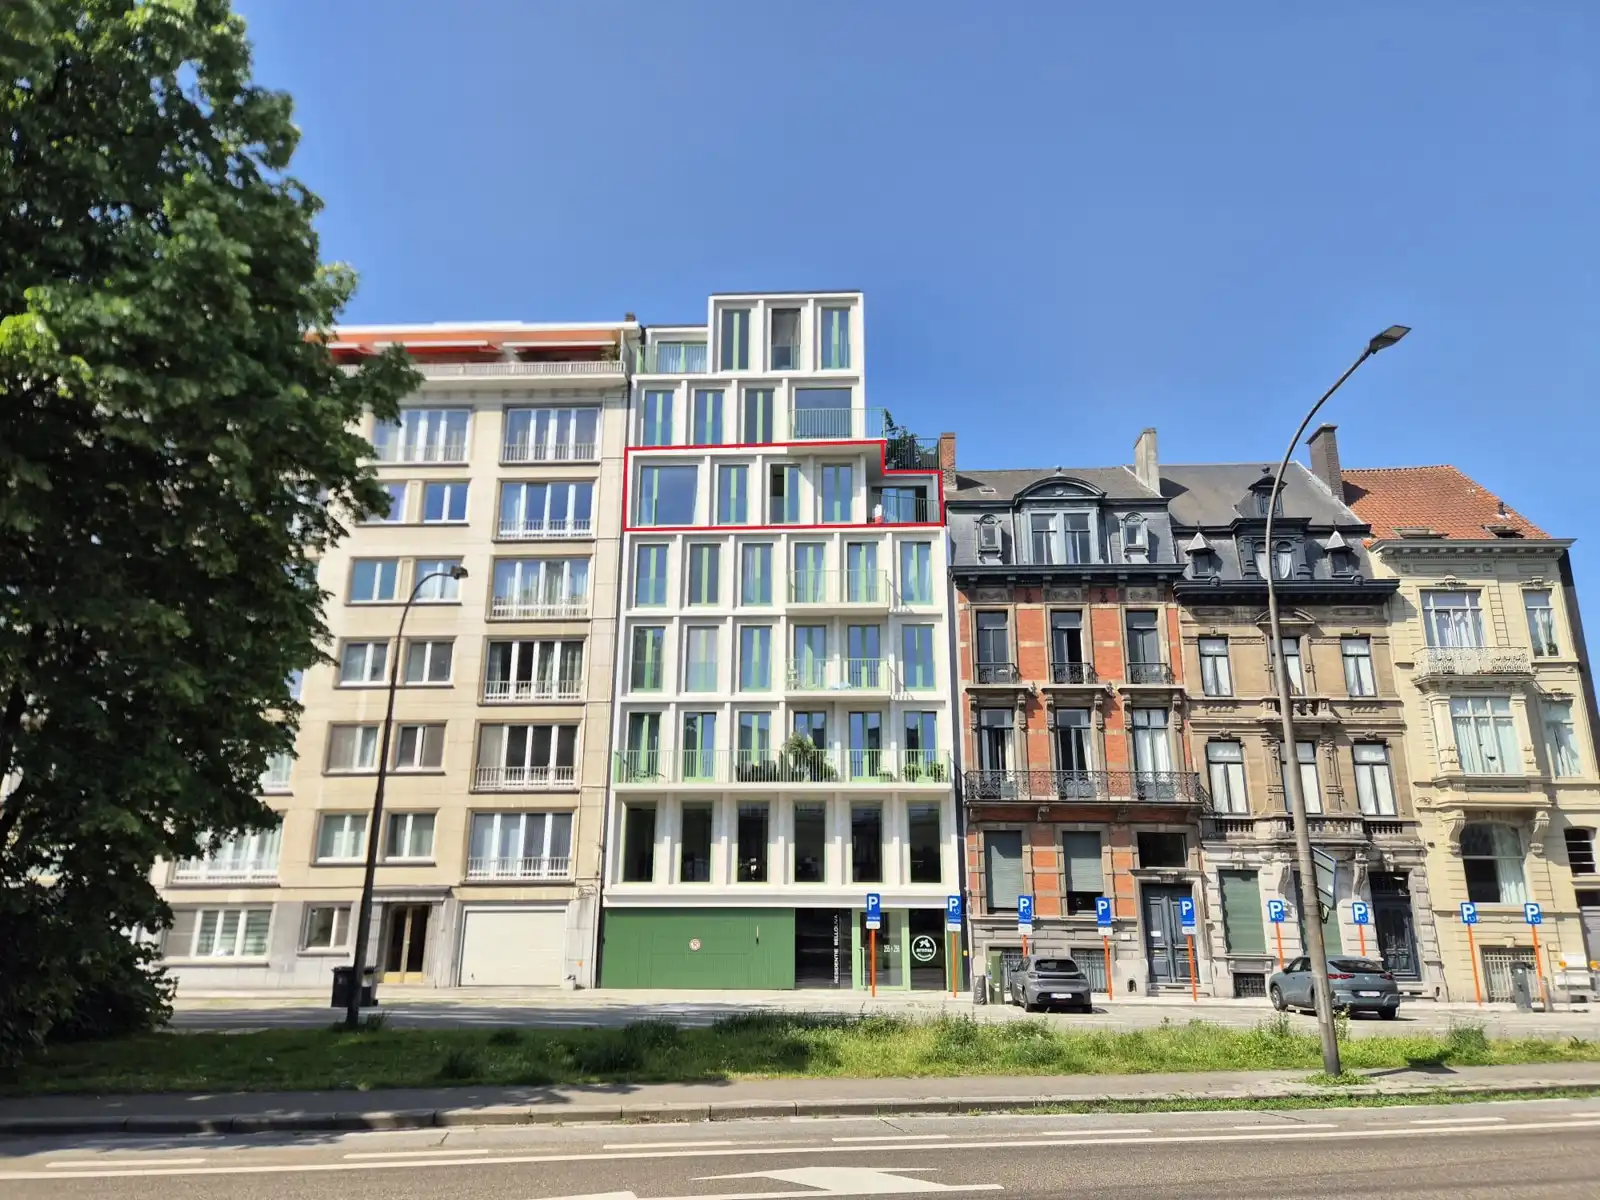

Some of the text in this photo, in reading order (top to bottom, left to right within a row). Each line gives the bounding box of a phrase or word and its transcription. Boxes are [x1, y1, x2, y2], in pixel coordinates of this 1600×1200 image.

[868, 896, 878, 911] P
[949, 898, 959, 912] P
[1019, 898, 1030, 912] P
[1097, 900, 1108, 915] P
[1181, 901, 1192, 916] P
[1269, 902, 1282, 919] P
[1353, 903, 1366, 921] P
[1461, 904, 1474, 921] P
[1525, 904, 1538, 922] P
